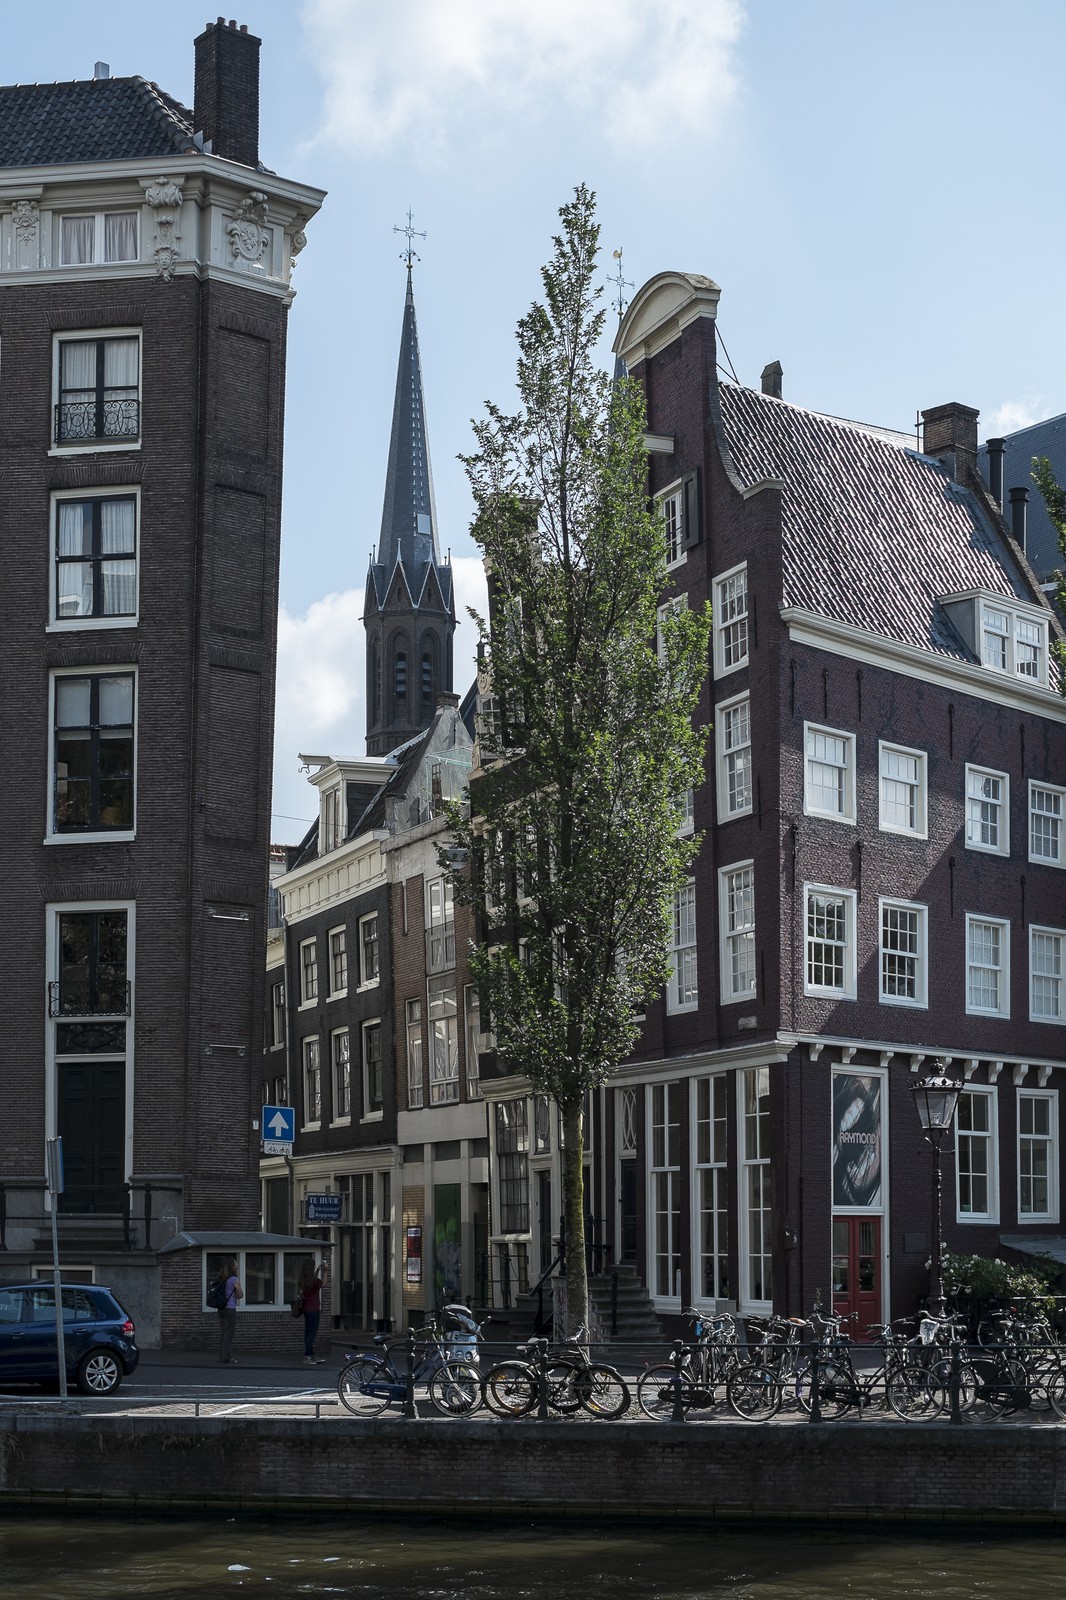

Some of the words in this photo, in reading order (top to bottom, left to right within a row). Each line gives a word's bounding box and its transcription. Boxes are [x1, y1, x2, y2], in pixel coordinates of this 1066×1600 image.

[839, 1132, 876, 1144] RAYMOND
[309, 1196, 318, 1204] TE
[319, 1196, 339, 1204] HUUR
